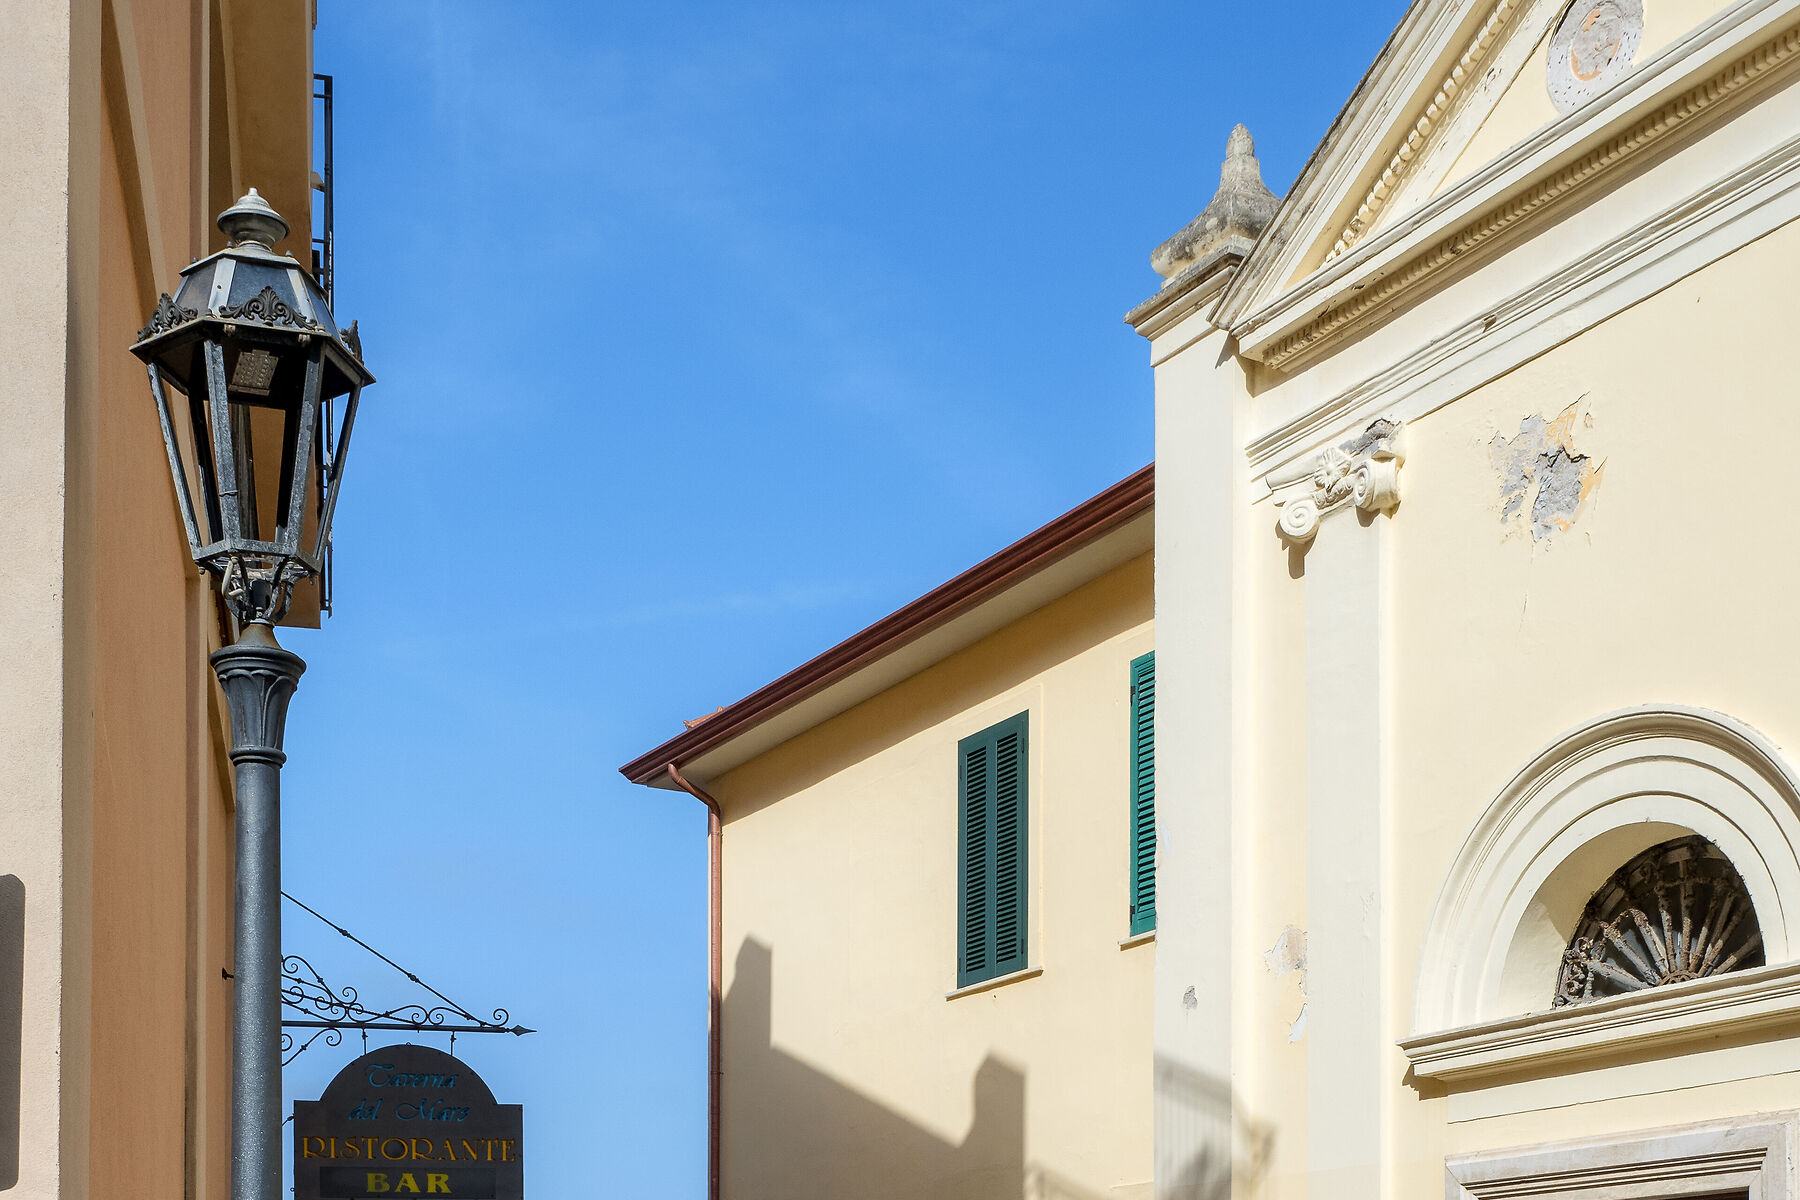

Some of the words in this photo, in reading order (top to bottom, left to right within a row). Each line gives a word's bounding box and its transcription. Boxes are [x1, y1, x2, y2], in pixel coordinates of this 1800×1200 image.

[364, 1063, 459, 1089] Taverna
[348, 1098, 383, 1121] del
[301, 1136, 516, 1162] RISTORANTE
[366, 1172, 452, 1194] BAR
